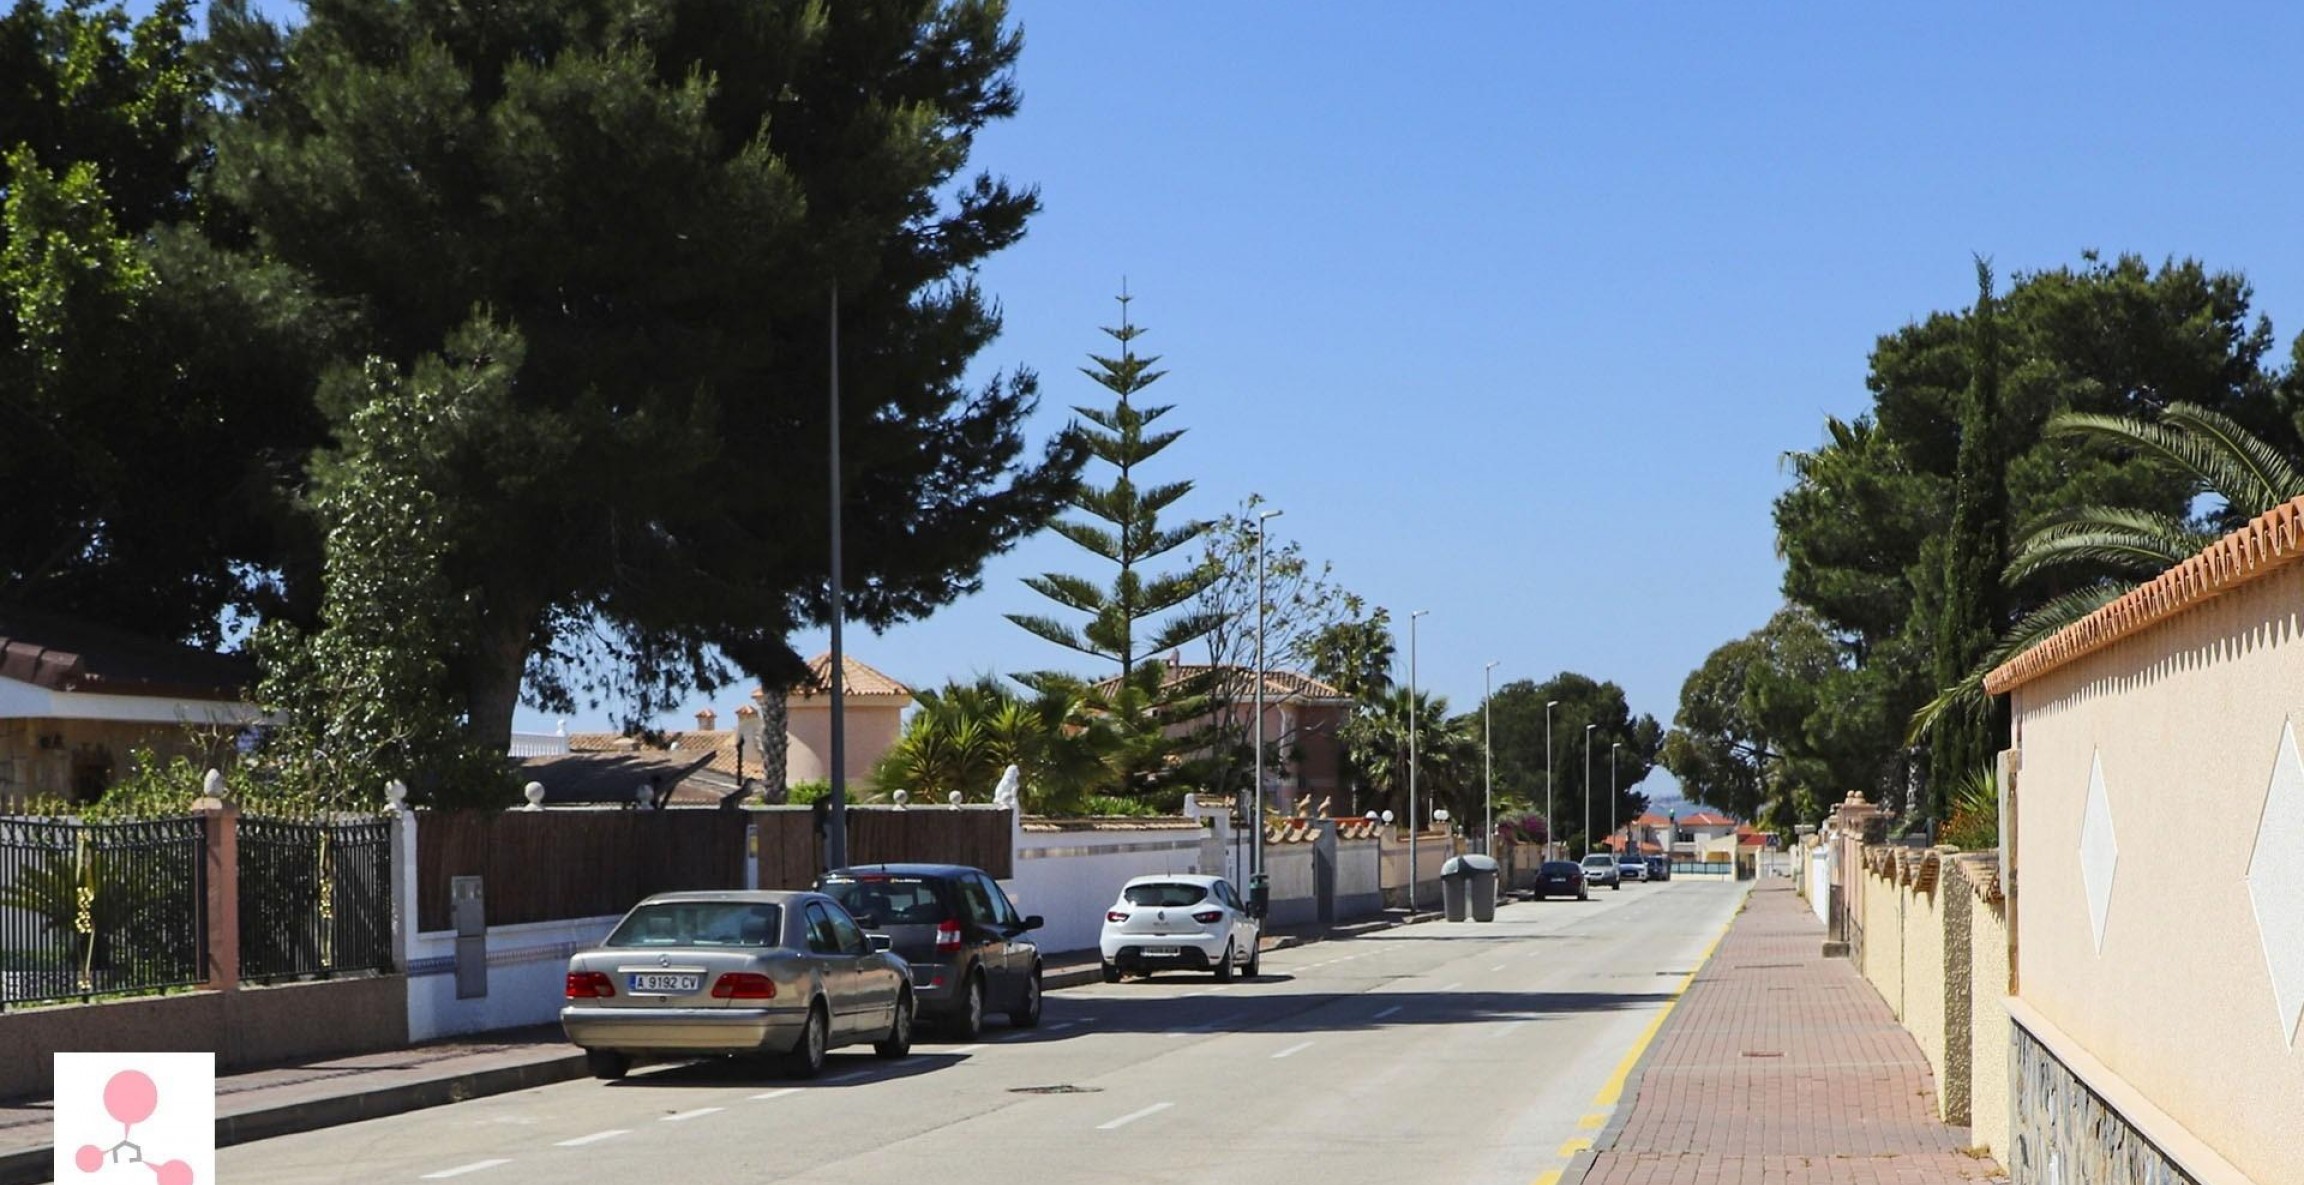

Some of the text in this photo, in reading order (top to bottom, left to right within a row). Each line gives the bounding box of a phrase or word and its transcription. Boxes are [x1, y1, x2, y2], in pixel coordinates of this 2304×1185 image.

[637, 976, 697, 989] A 9192 CV
